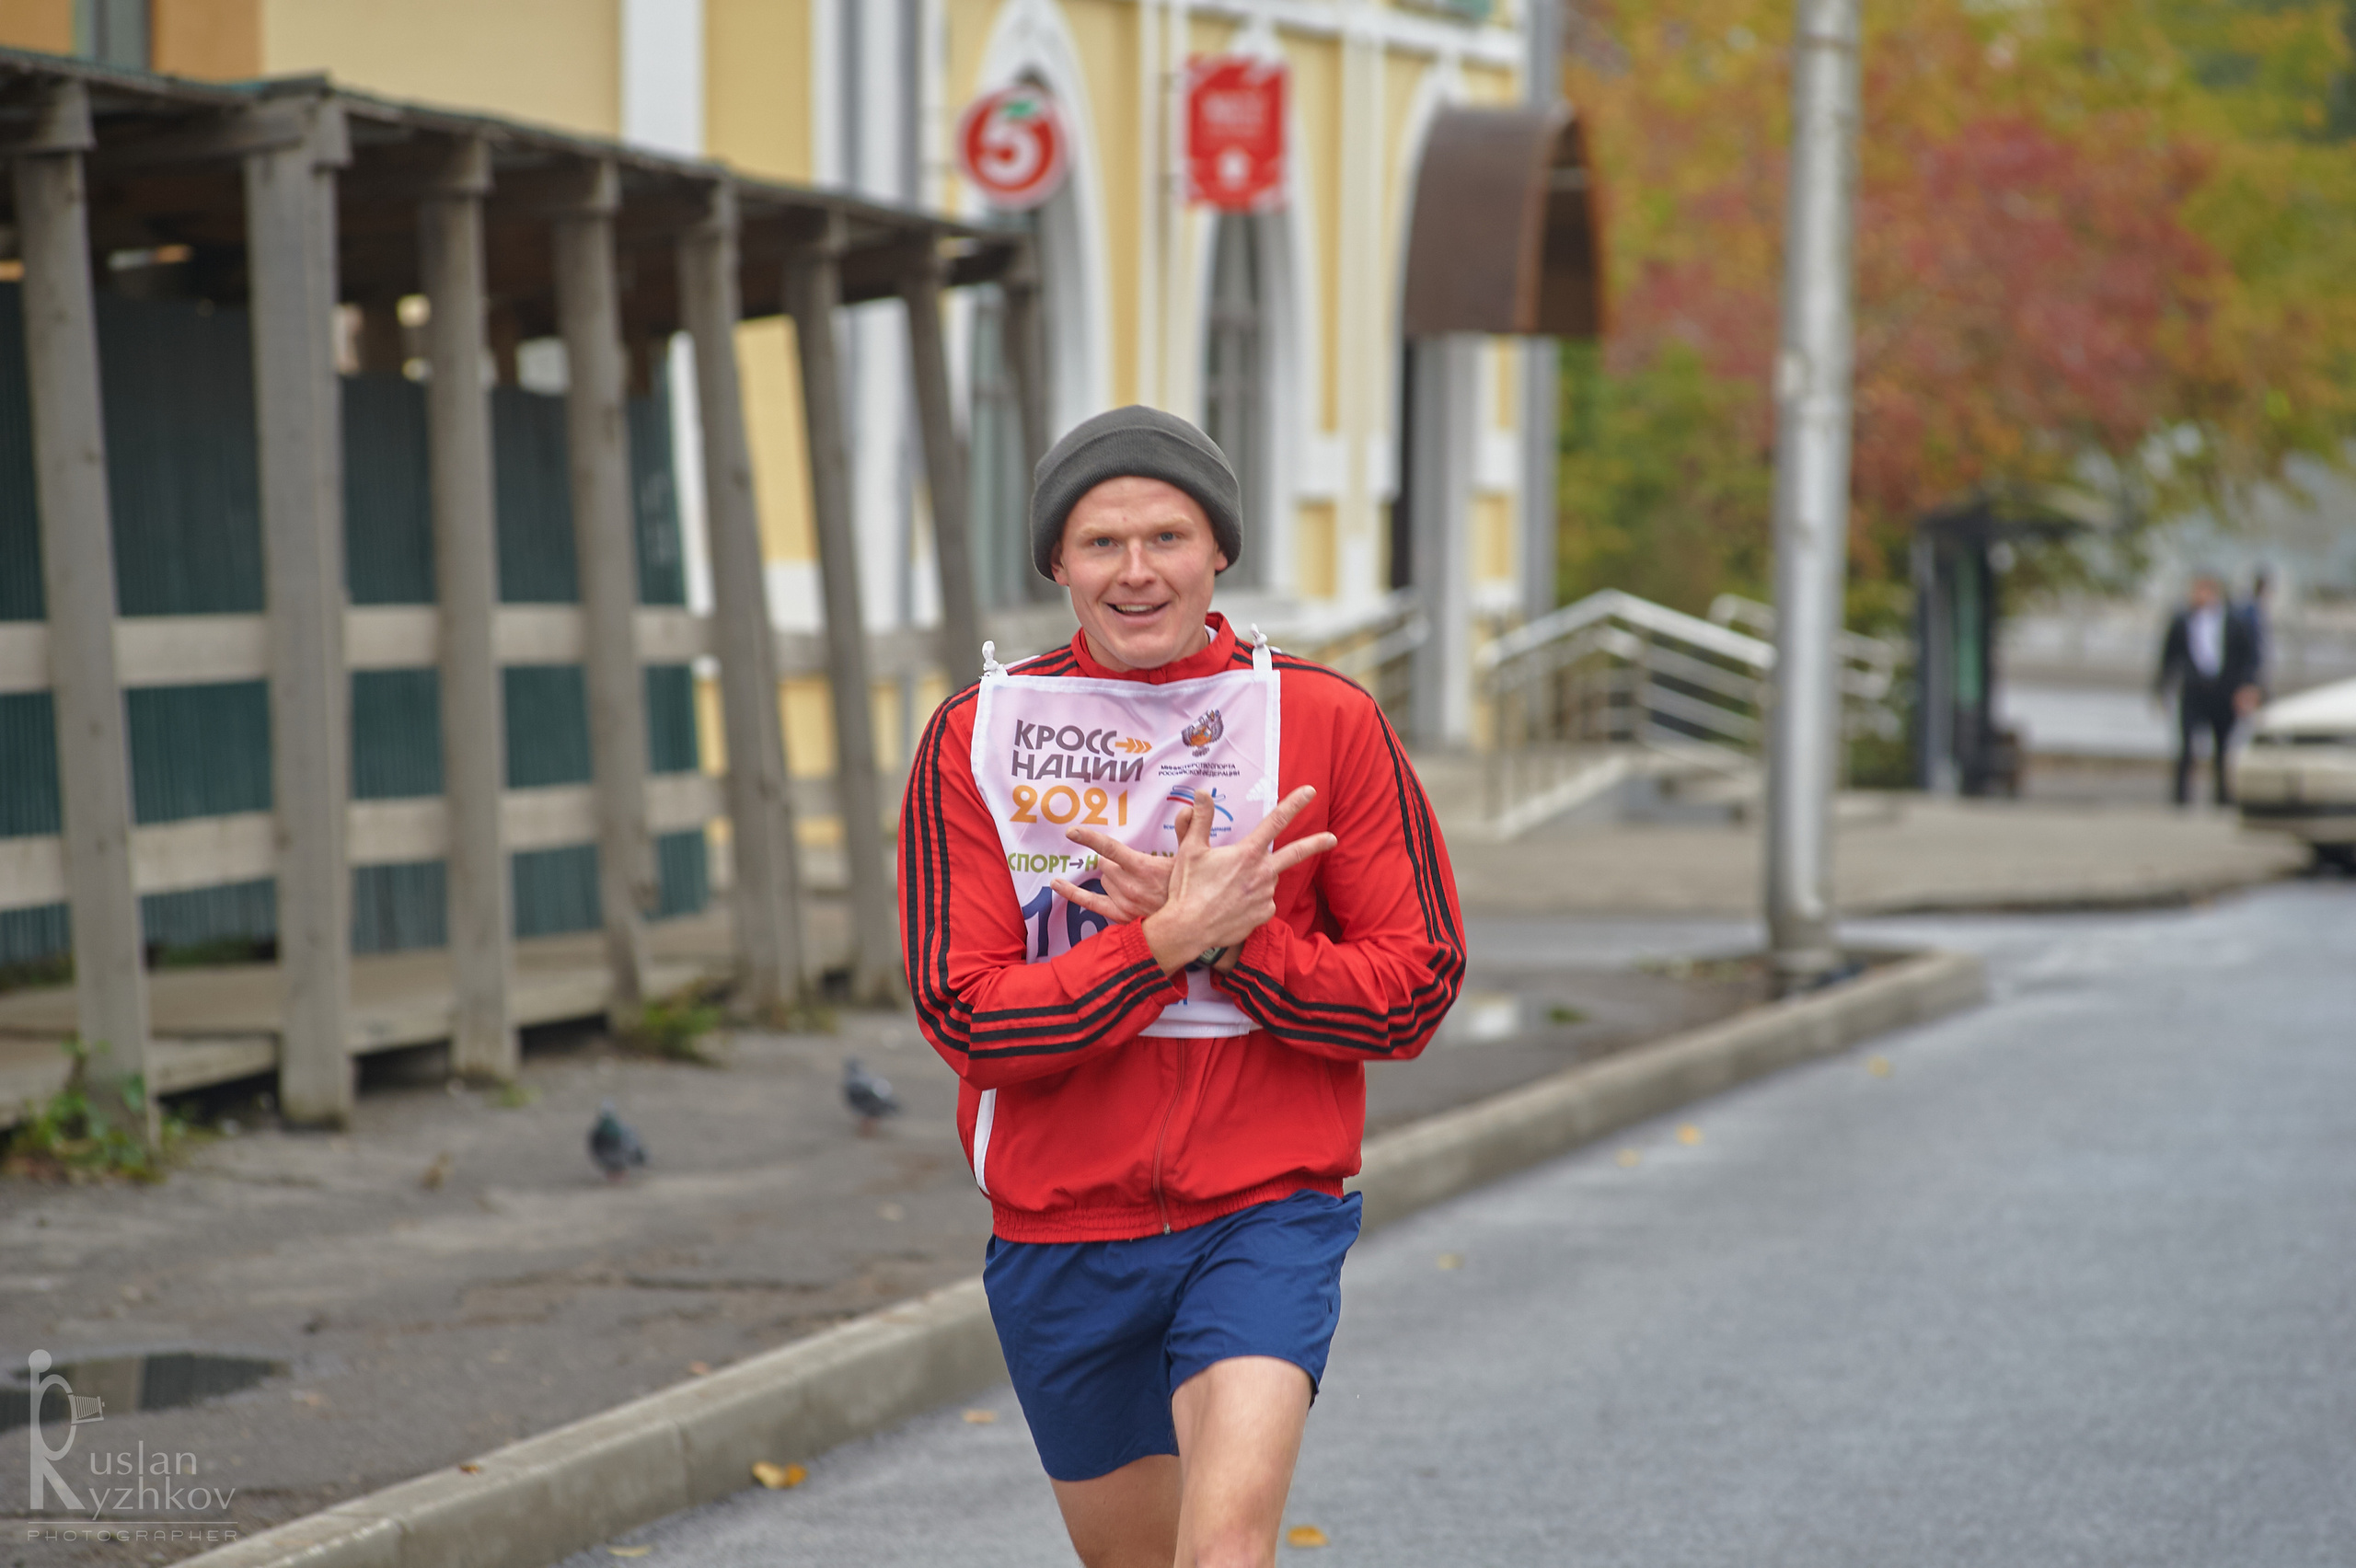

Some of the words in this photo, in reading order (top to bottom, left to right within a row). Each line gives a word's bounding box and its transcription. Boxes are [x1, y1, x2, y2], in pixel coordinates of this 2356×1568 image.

[1014, 719, 1117, 757] КРОСС
[1011, 750, 1144, 783] НАЦИИ
[1010, 785, 1128, 827] 2021
[1008, 853, 1070, 873] СПОРТ
